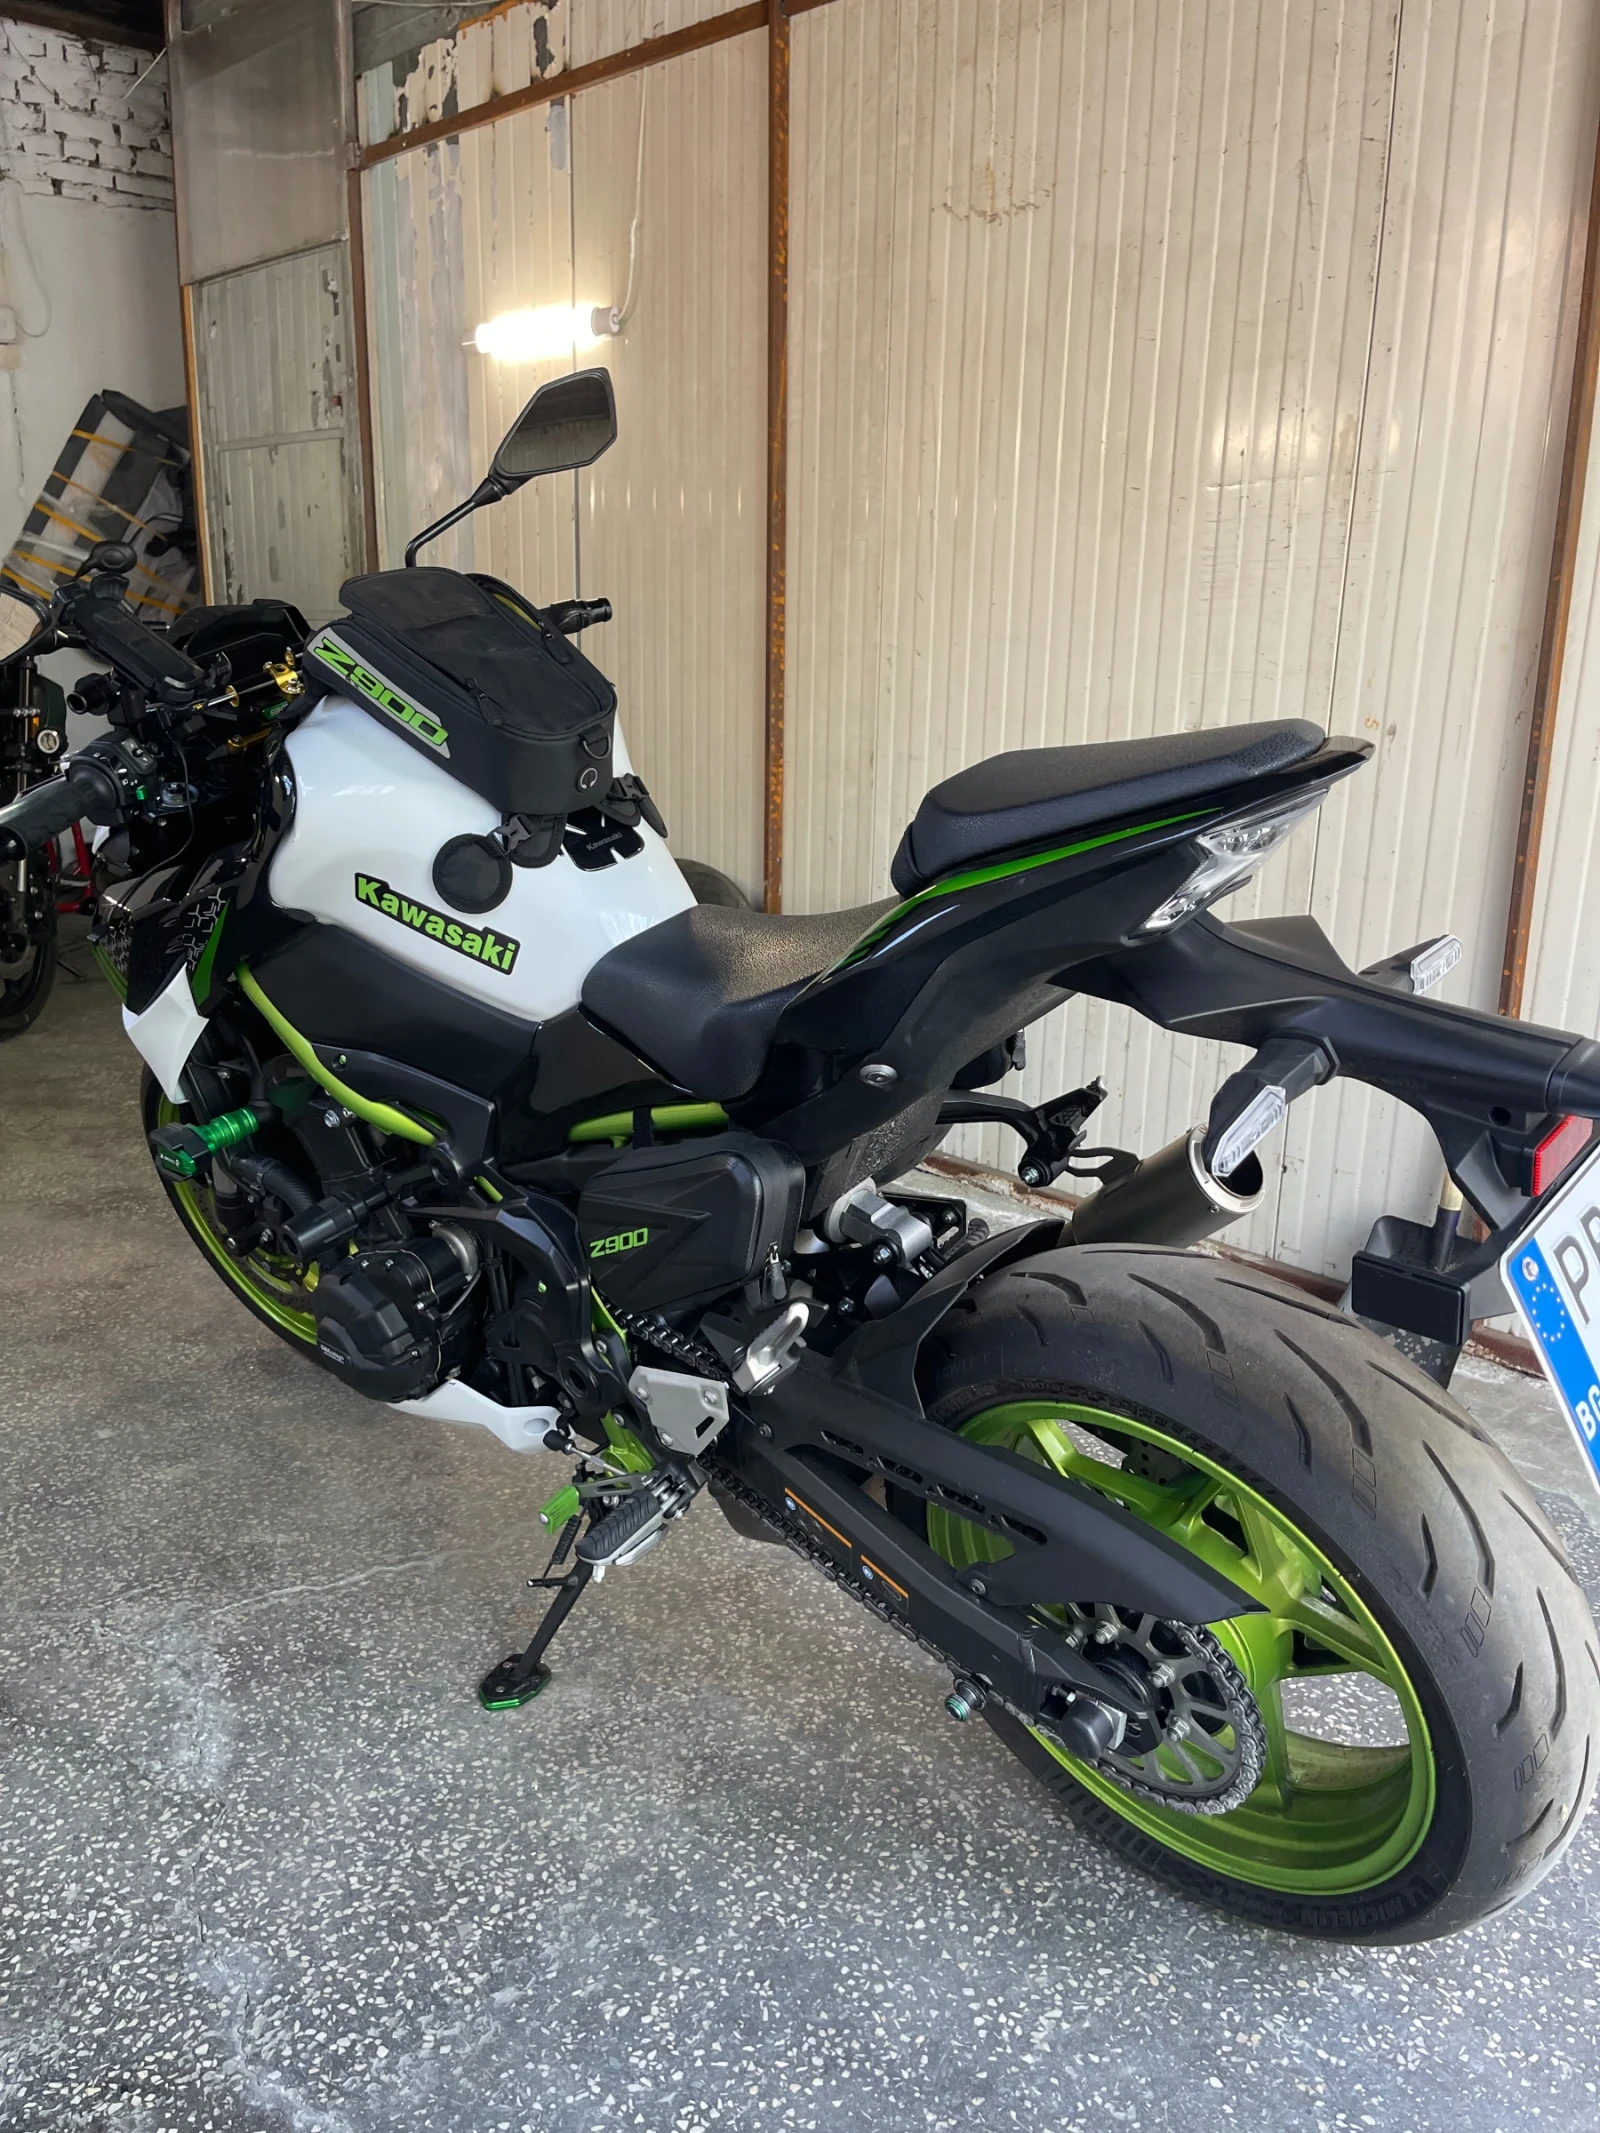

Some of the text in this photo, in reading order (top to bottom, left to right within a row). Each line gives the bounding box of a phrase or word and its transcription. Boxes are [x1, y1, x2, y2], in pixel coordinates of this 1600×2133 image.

[314, 637, 449, 746] Z900
[586, 832, 622, 851] Kawasaki
[358, 877, 516, 971] Kawasaki
[590, 1228, 648, 1258] Z900
[1300, 1897, 1403, 1928] MICHELIN
